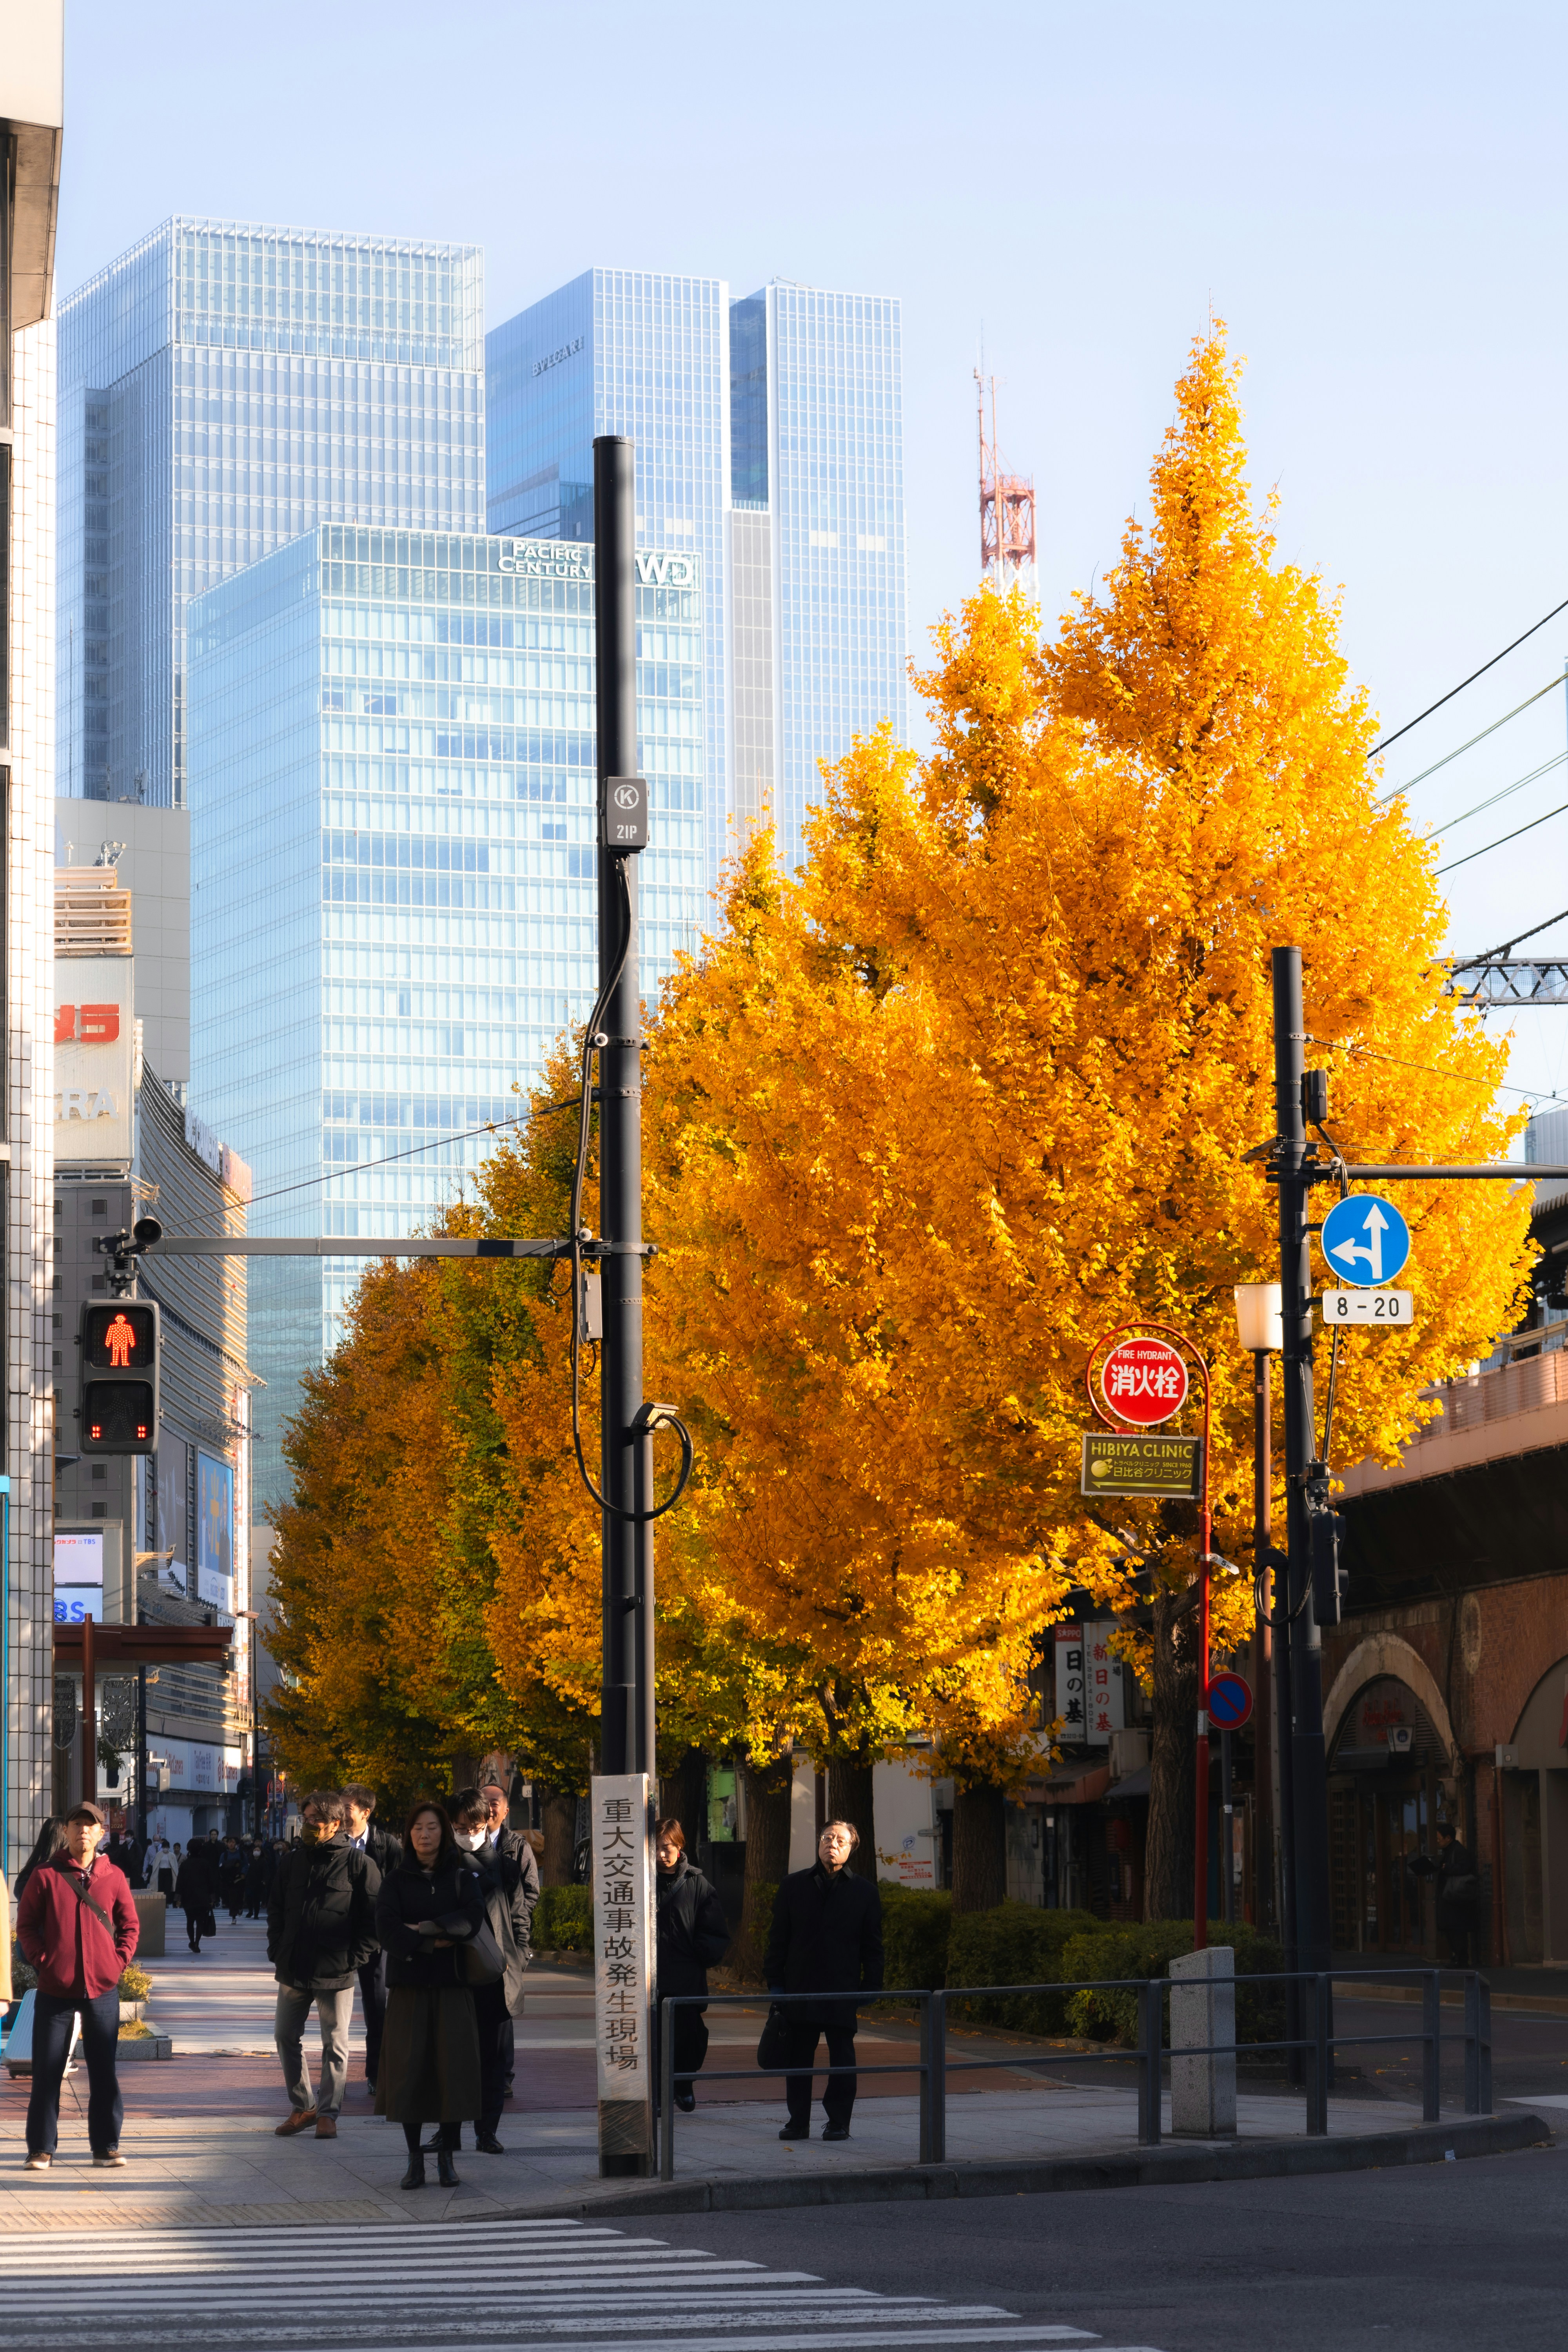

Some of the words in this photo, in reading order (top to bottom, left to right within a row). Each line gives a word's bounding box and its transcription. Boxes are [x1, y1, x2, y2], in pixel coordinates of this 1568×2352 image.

[532, 336, 582, 377] BVLGARI
[513, 541, 582, 561] PACIFIC
[498, 556, 592, 578] CENTURY
[620, 789, 633, 804] K
[54, 1087, 118, 1120] RA
[1118, 1350, 1135, 1359] FIRE
[1137, 1350, 1172, 1360] HYDRANT
[1111, 1364, 1180, 1398] 消火栓
[1091, 1442, 1140, 1456] HIBIYA
[1143, 1444, 1192, 1458] CLINIC
[1114, 1467, 1192, 1479] 日比谷クリニック
[1221, 1560, 1231, 1570] 5m
[1064, 1650, 1083, 1724] 日の基
[1093, 1643, 1113, 1732] 新日の基
[602, 1798, 638, 2070] 重大交通事故発生現場
